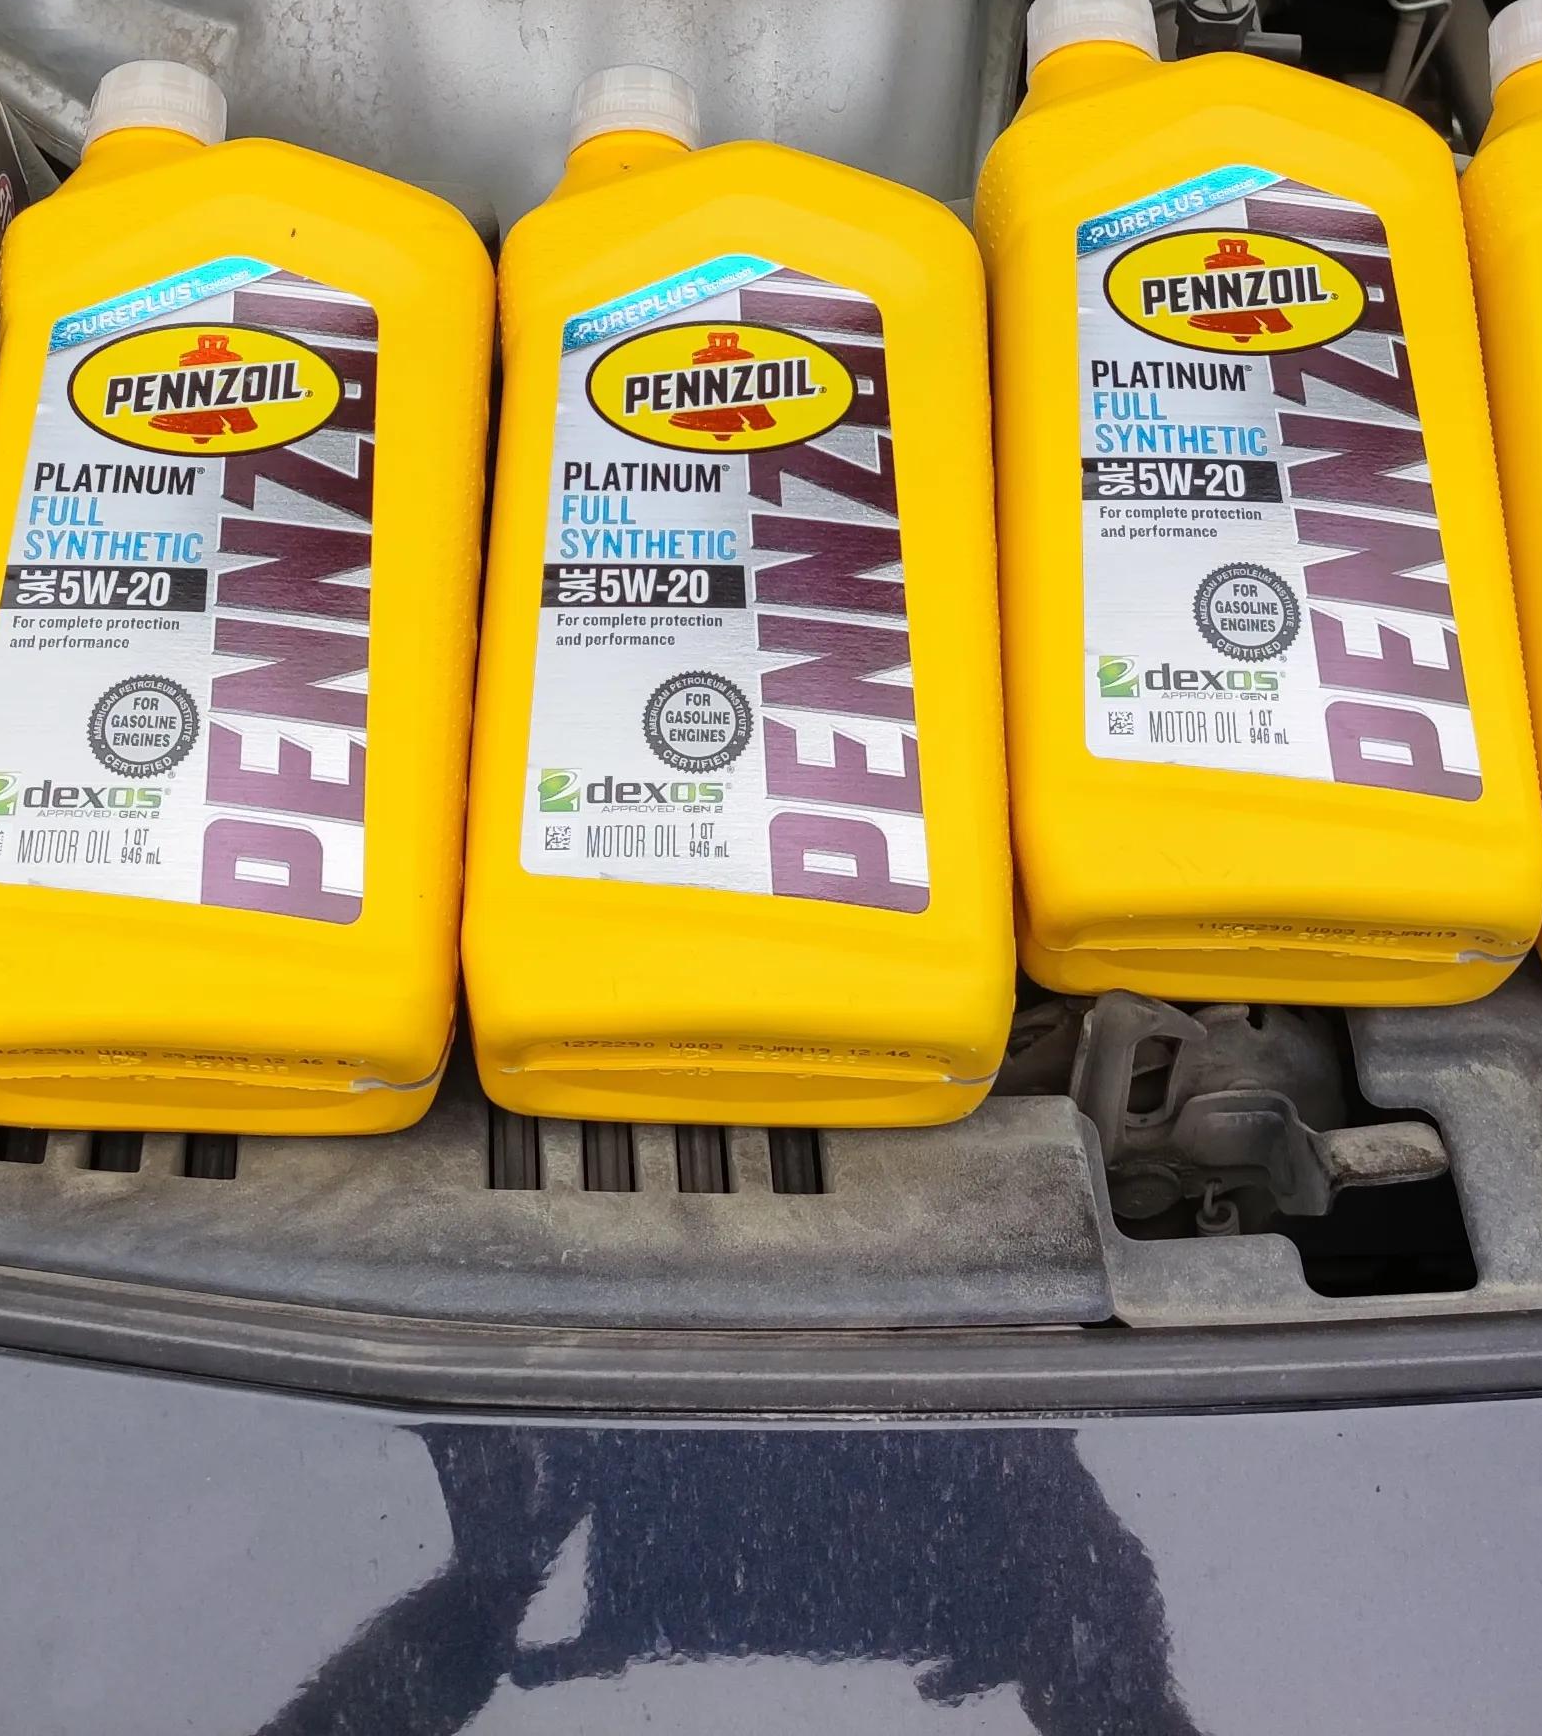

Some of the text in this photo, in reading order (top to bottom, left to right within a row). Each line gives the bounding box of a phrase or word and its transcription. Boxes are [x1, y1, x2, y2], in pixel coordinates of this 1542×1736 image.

[1087, 193, 1204, 243] PUREPLUS
[1143, 266, 1327, 315] PENNZOIL
[66, 284, 192, 337] PUREPLUS
[576, 286, 698, 338] PUREPLUS
[104, 362, 302, 415] PENNZOIL
[625, 360, 816, 413] PENNZOIL
[1091, 360, 1246, 391] PLATINUM
[1094, 392, 1168, 420] FULL
[1096, 425, 1268, 456] SYNTHETIC
[34, 463, 196, 496] PLATINUM
[563, 462, 721, 492] PLATINUM
[1098, 463, 1246, 497] SAE 5W-20
[29, 496, 104, 526] FULL
[562, 495, 636, 524] FULL
[1100, 506, 1262, 522] For complete protection
[23, 529, 204, 562] SYNTHETIC
[560, 529, 737, 559] SYNTHETIC
[1100, 525, 1217, 540] and performance
[16, 568, 171, 607] SAE 5W-20
[558, 569, 709, 603] SAE 5W-20
[1233, 584, 1258, 598] FOR
[1215, 601, 1278, 615] GASOLINE
[1220, 619, 1276, 633] ENGINES
[1145, 663, 1278, 691] dexos
[685, 693, 711, 706] FOR
[665, 710, 730, 725] GASOLINE
[1149, 711, 1241, 744] MOTOR OIL
[669, 729, 726, 742] ENGINES
[23, 780, 162, 809] dexos
[586, 776, 724, 803] dexos
[17, 831, 112, 864] MOTOR OIL
[586, 825, 680, 858] MOTOR OIL
